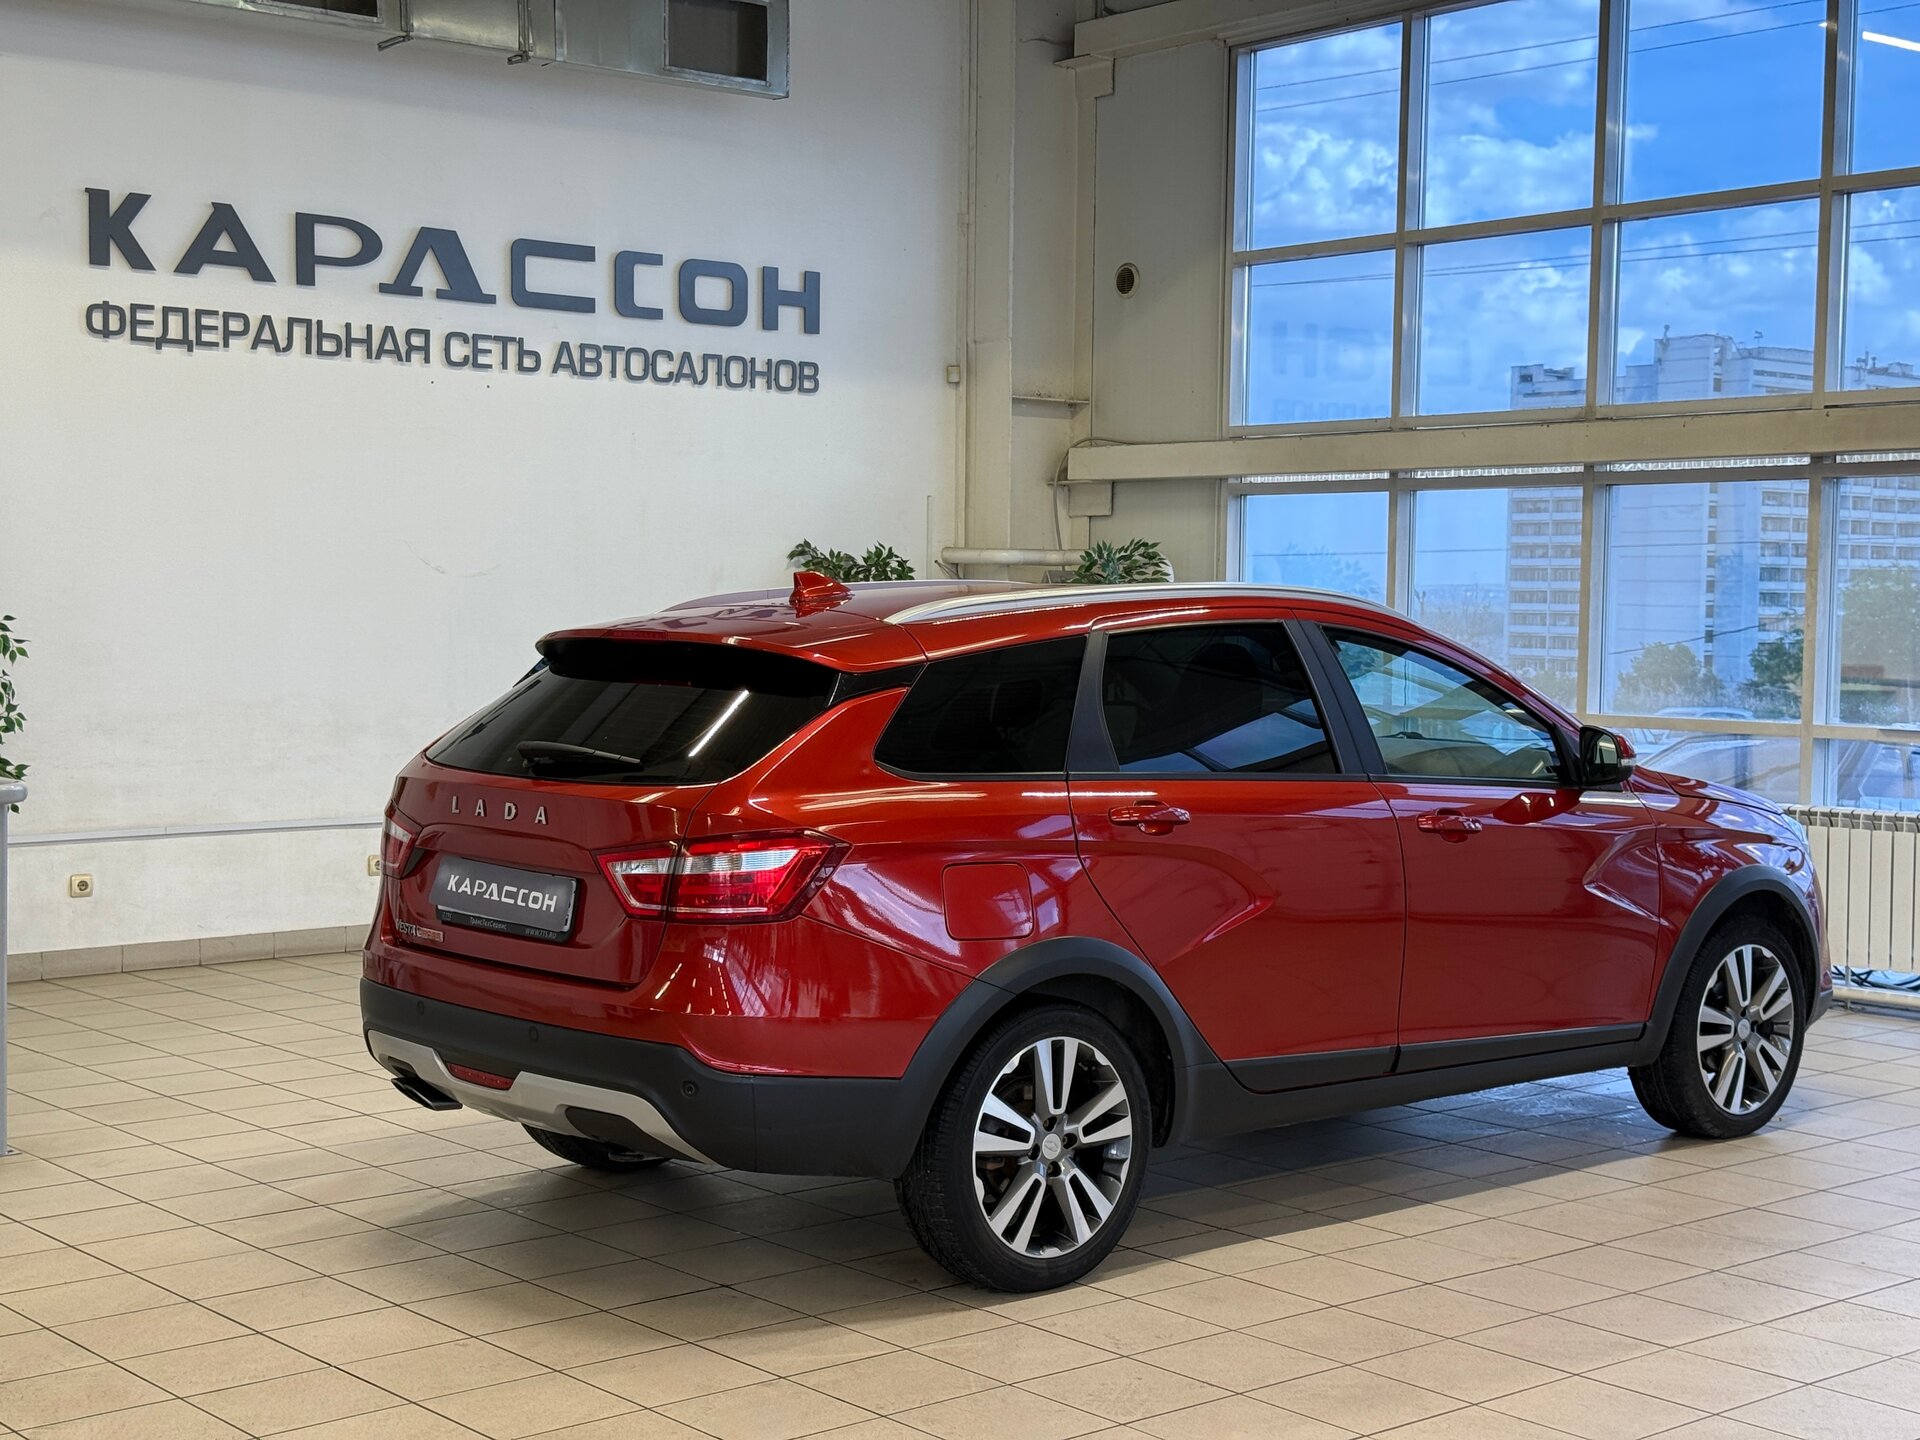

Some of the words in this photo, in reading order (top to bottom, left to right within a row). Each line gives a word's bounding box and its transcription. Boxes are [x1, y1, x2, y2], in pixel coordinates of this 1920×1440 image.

[85, 187, 821, 335] КАРАССОН
[85, 300, 431, 364] ФЕДЕРАЛЬНАЯ
[444, 331, 542, 373] СЕТЬ
[551, 341, 820, 394] АВТОСАЛОНОВ
[451, 795, 548, 825] LADA
[447, 874, 558, 913] КАРАССОН
